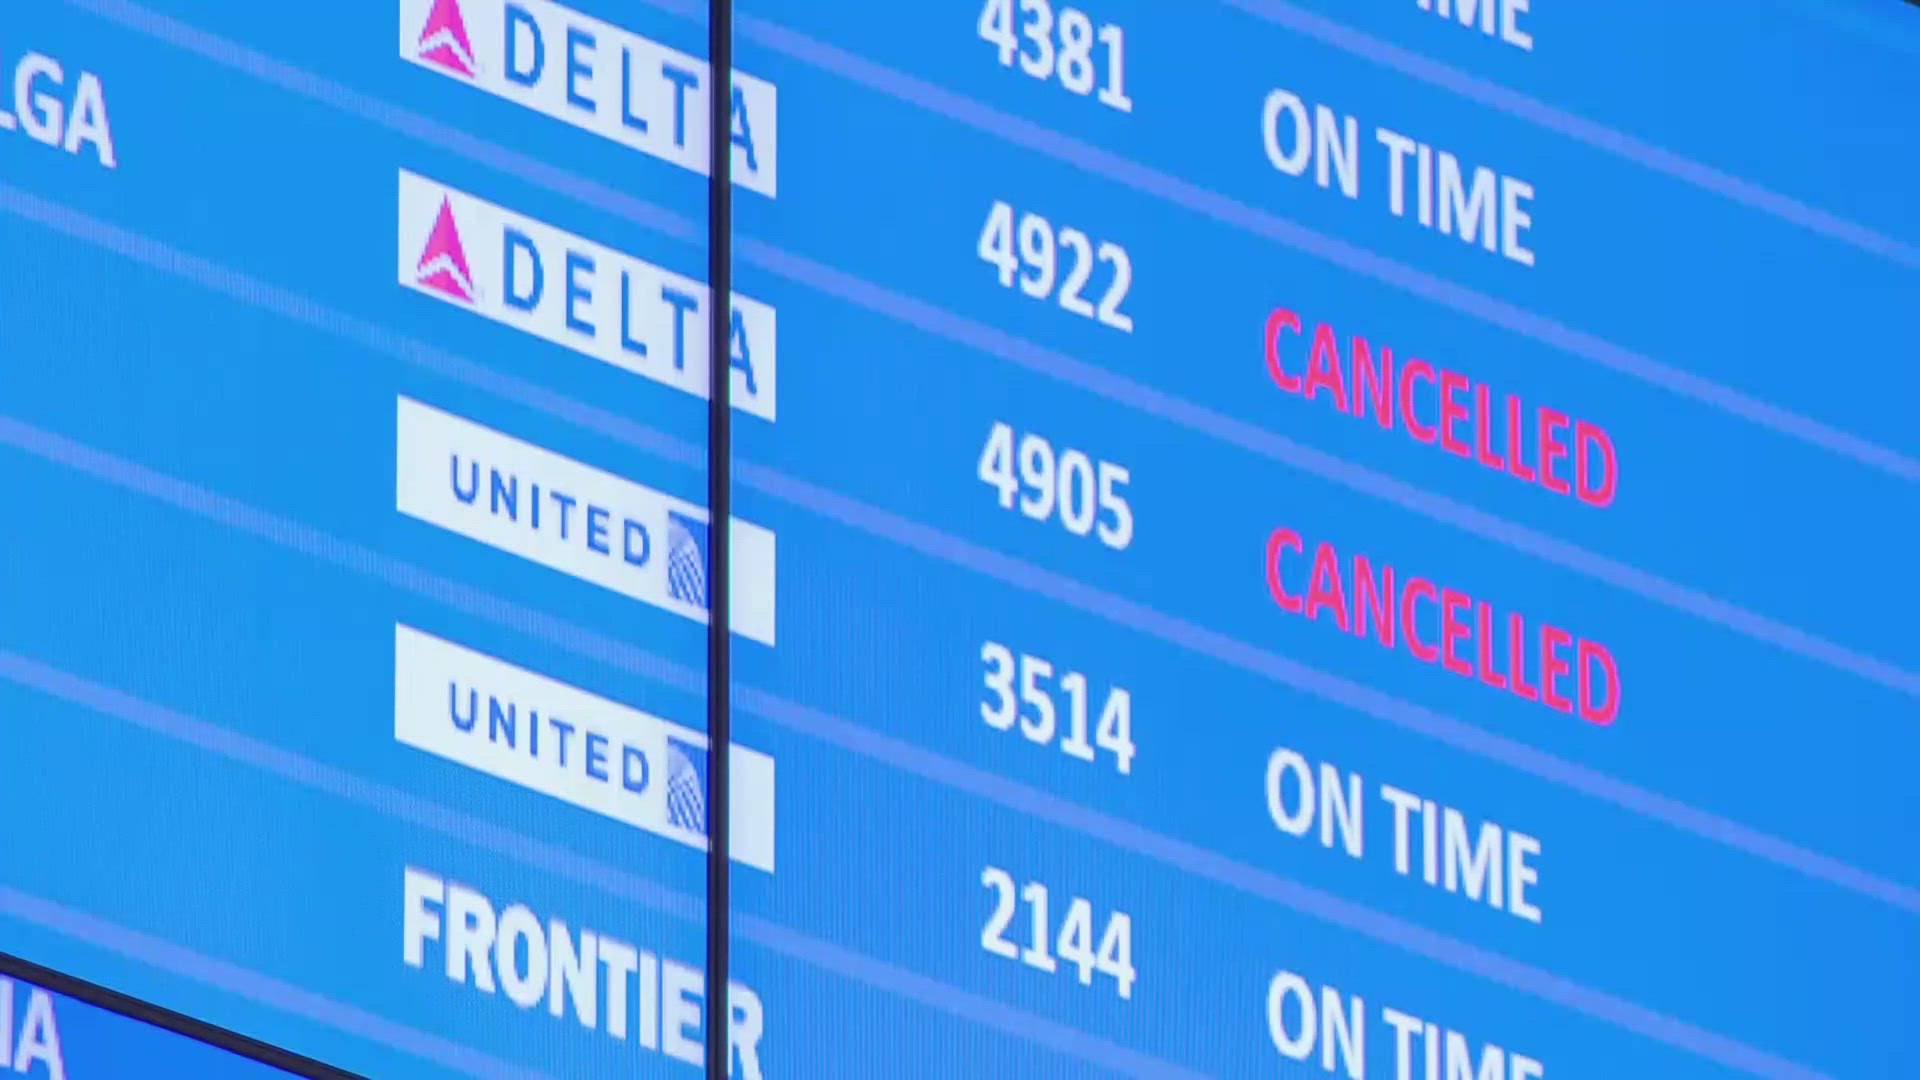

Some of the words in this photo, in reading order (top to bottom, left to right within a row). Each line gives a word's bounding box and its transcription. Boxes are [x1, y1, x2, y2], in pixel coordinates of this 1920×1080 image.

[0, 51, 117, 168] GA
[504, 3, 758, 172] DELTA
[979, 0, 1132, 112] 4381
[1263, 89, 1358, 199] ON
[1376, 128, 1534, 266] TIME
[503, 226, 758, 395] DELTA
[978, 201, 1133, 333] 4922
[1264, 308, 1618, 508] CANCELLED
[452, 455, 651, 568] UNITED
[978, 423, 1133, 549] 4905
[1266, 528, 1621, 726] CANCELLED
[450, 682, 650, 795] UNITED
[980, 642, 1136, 774] 3514
[1266, 748, 1363, 857] ON
[1381, 785, 1542, 922] TIME
[403, 867, 764, 1080] FRONTIER
[980, 867, 1137, 1000] 2144
[1267, 970, 1365, 1080] ON
